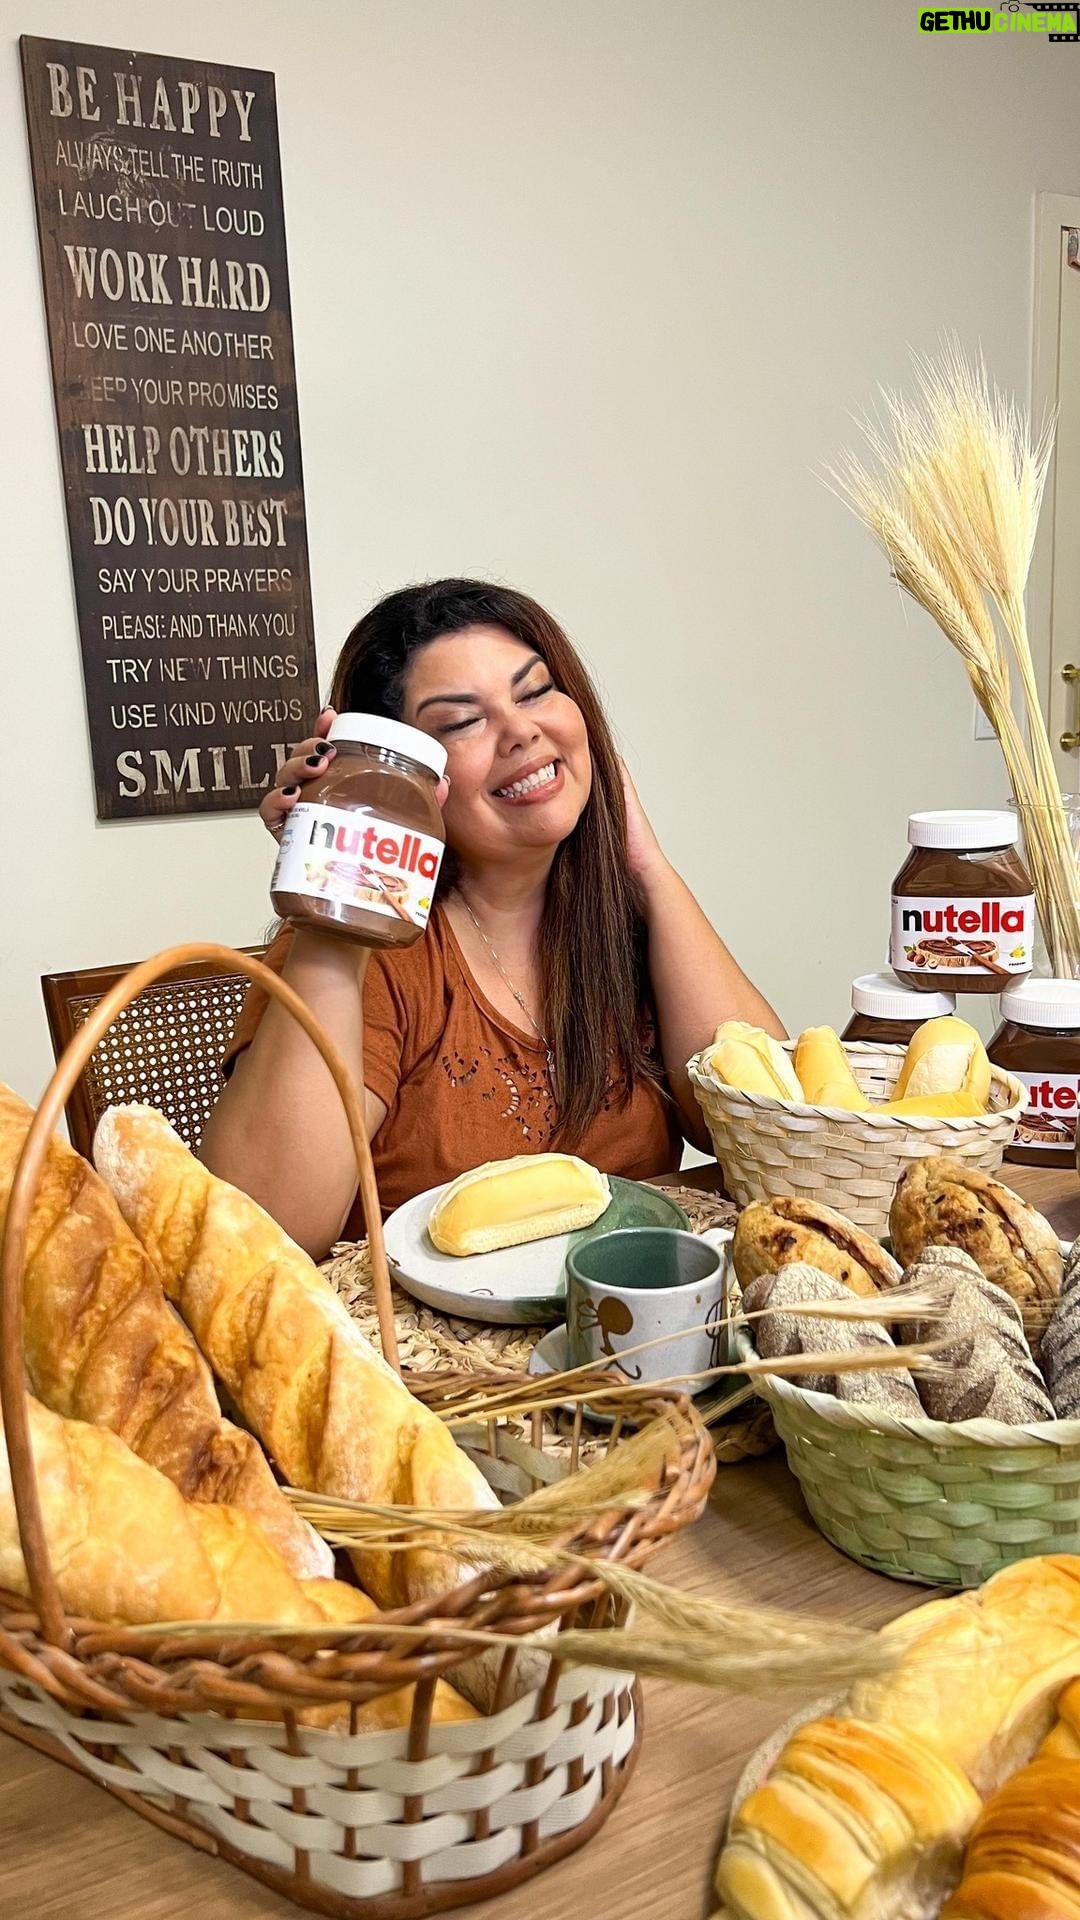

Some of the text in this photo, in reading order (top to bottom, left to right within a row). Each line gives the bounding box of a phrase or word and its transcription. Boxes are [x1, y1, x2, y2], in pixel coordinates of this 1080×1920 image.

[46, 62, 256, 142] BE HAPPY
[56, 139, 263, 191] ALWAYS TELL THE TRUTH
[58, 189, 142, 224] LAUGH
[203, 205, 265, 236] LOUD
[63, 245, 271, 313] WORK HARD
[72, 321, 274, 360] LOVE ONE ANOTHER
[78, 376, 279, 410] EEP YOUR PROMISES
[82, 423, 284, 478] HELP OTHERS
[89, 497, 288, 547] DO YOUR BEST
[98, 568, 293, 593] SAY YOUR PRAYERS
[102, 613, 295, 640] PLEASE AND THANK YOU
[106, 655, 299, 684] TRY NEW THINGS
[111, 698, 303, 729] USE KIND WORDS
[309, 820, 439, 881] nutella
[902, 902, 1024, 933] nutella
